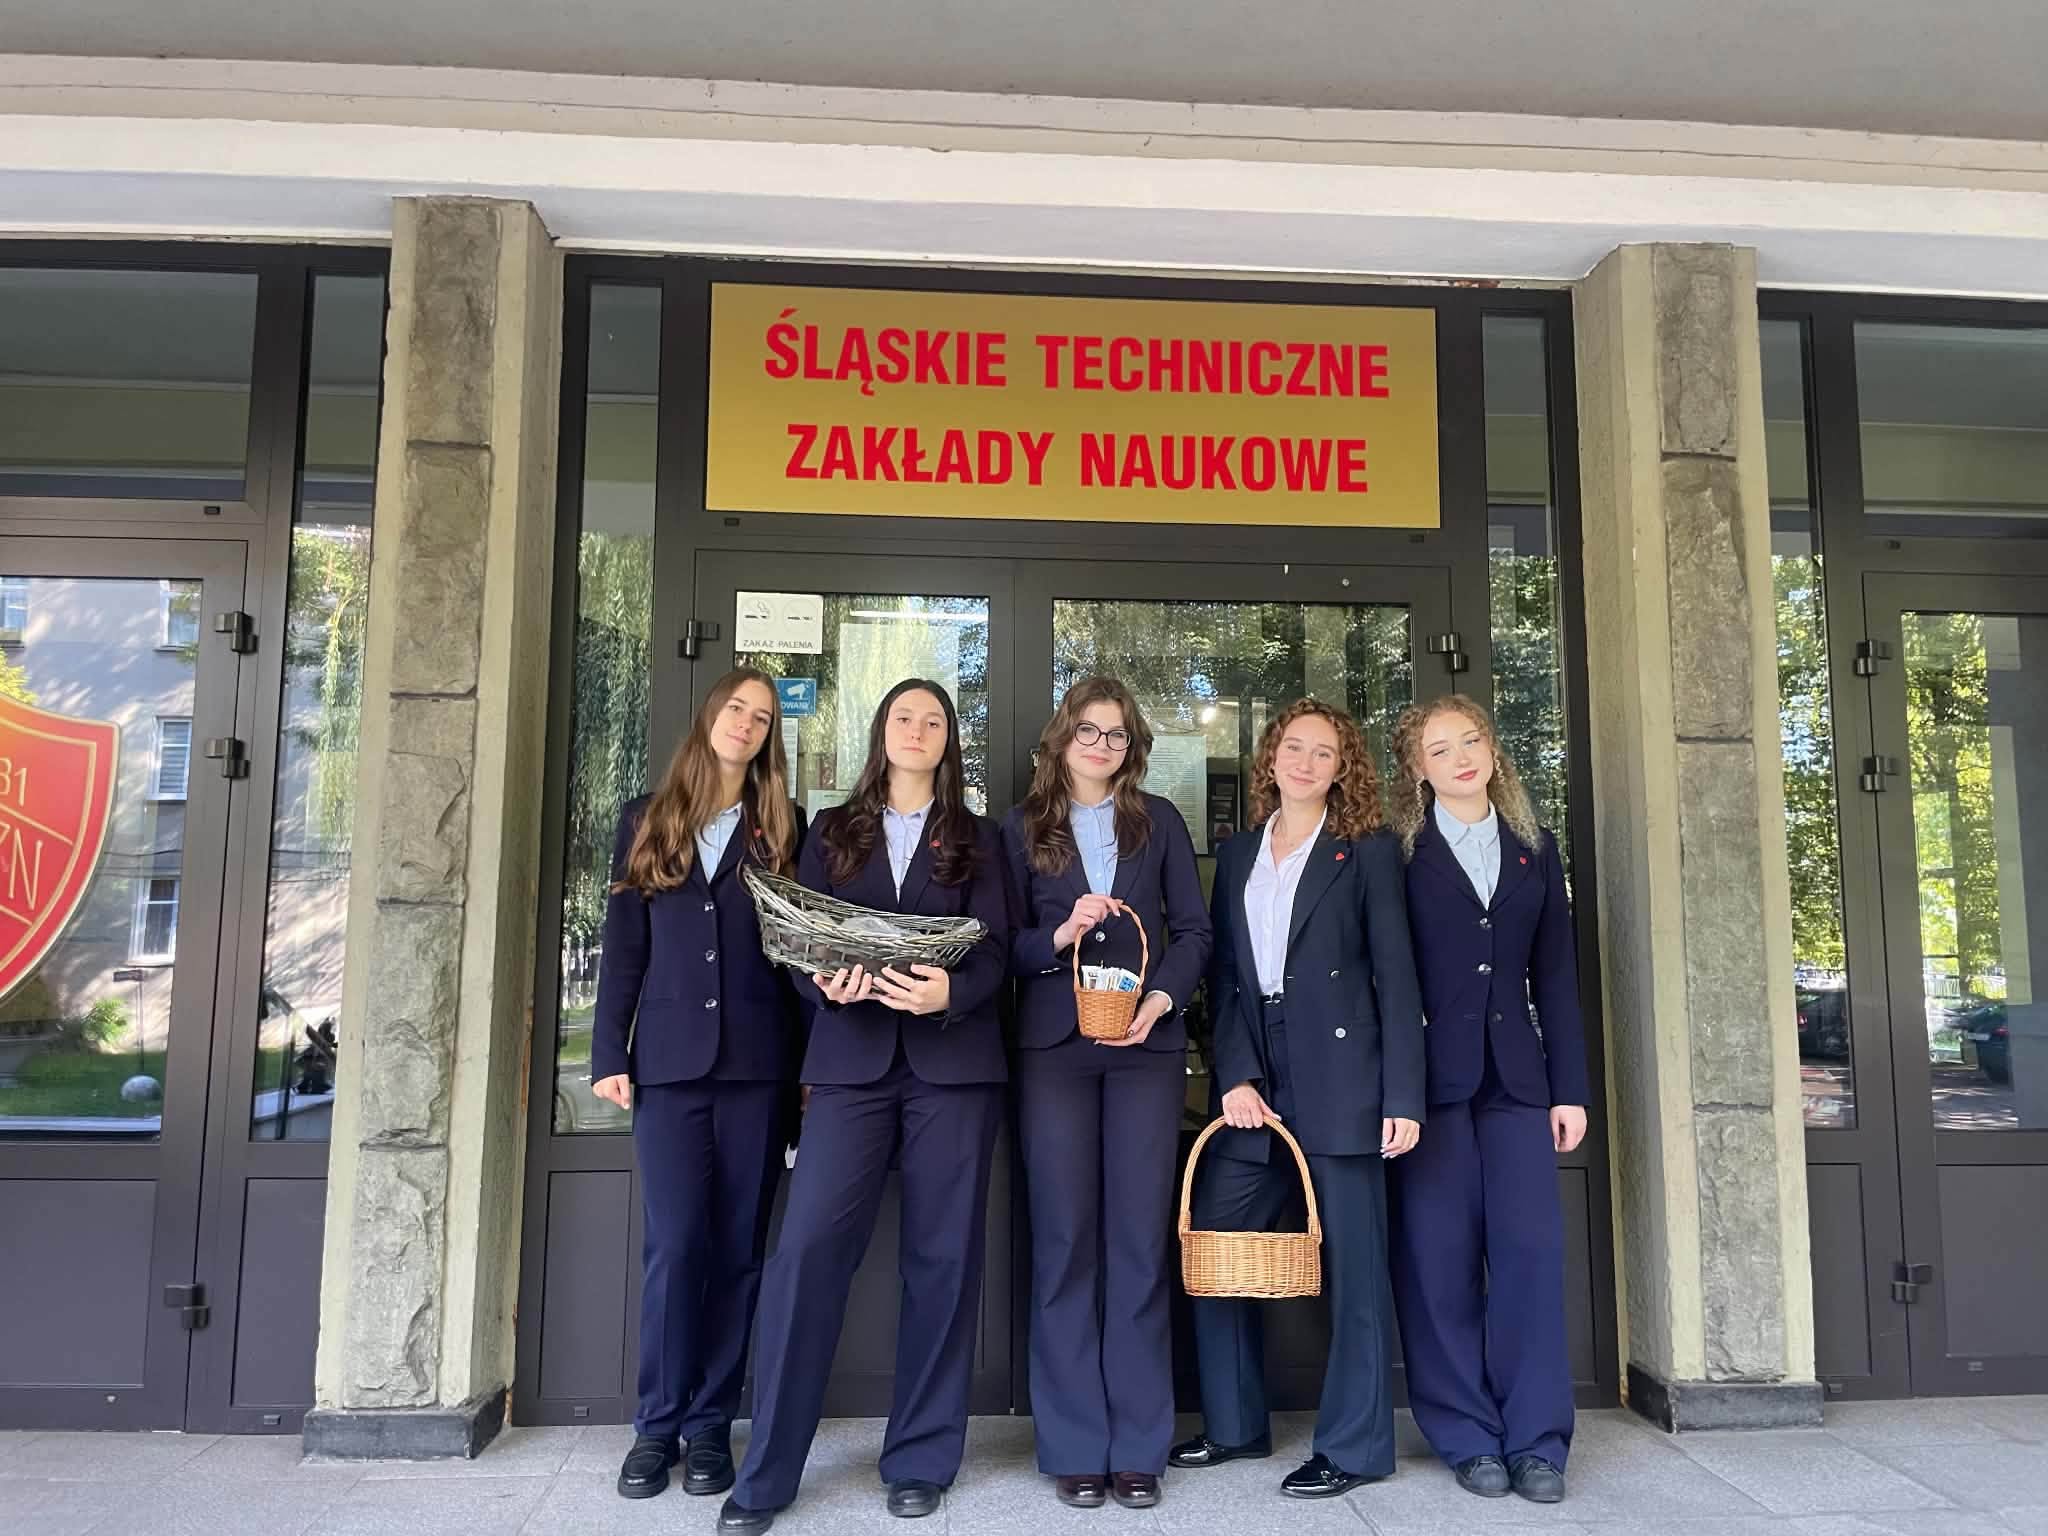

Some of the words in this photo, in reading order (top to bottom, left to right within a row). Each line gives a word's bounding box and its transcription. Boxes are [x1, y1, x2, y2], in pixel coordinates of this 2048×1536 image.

[764, 307, 1007, 397] ŚLĄSKIE
[1035, 334, 1390, 399] TECHNICZNE
[785, 422, 1056, 487] ZAKŁADY
[1080, 431, 1369, 494] NAUKOWE
[743, 639, 774, 648] ZAKAZ
[778, 640, 814, 649] PALENIA
